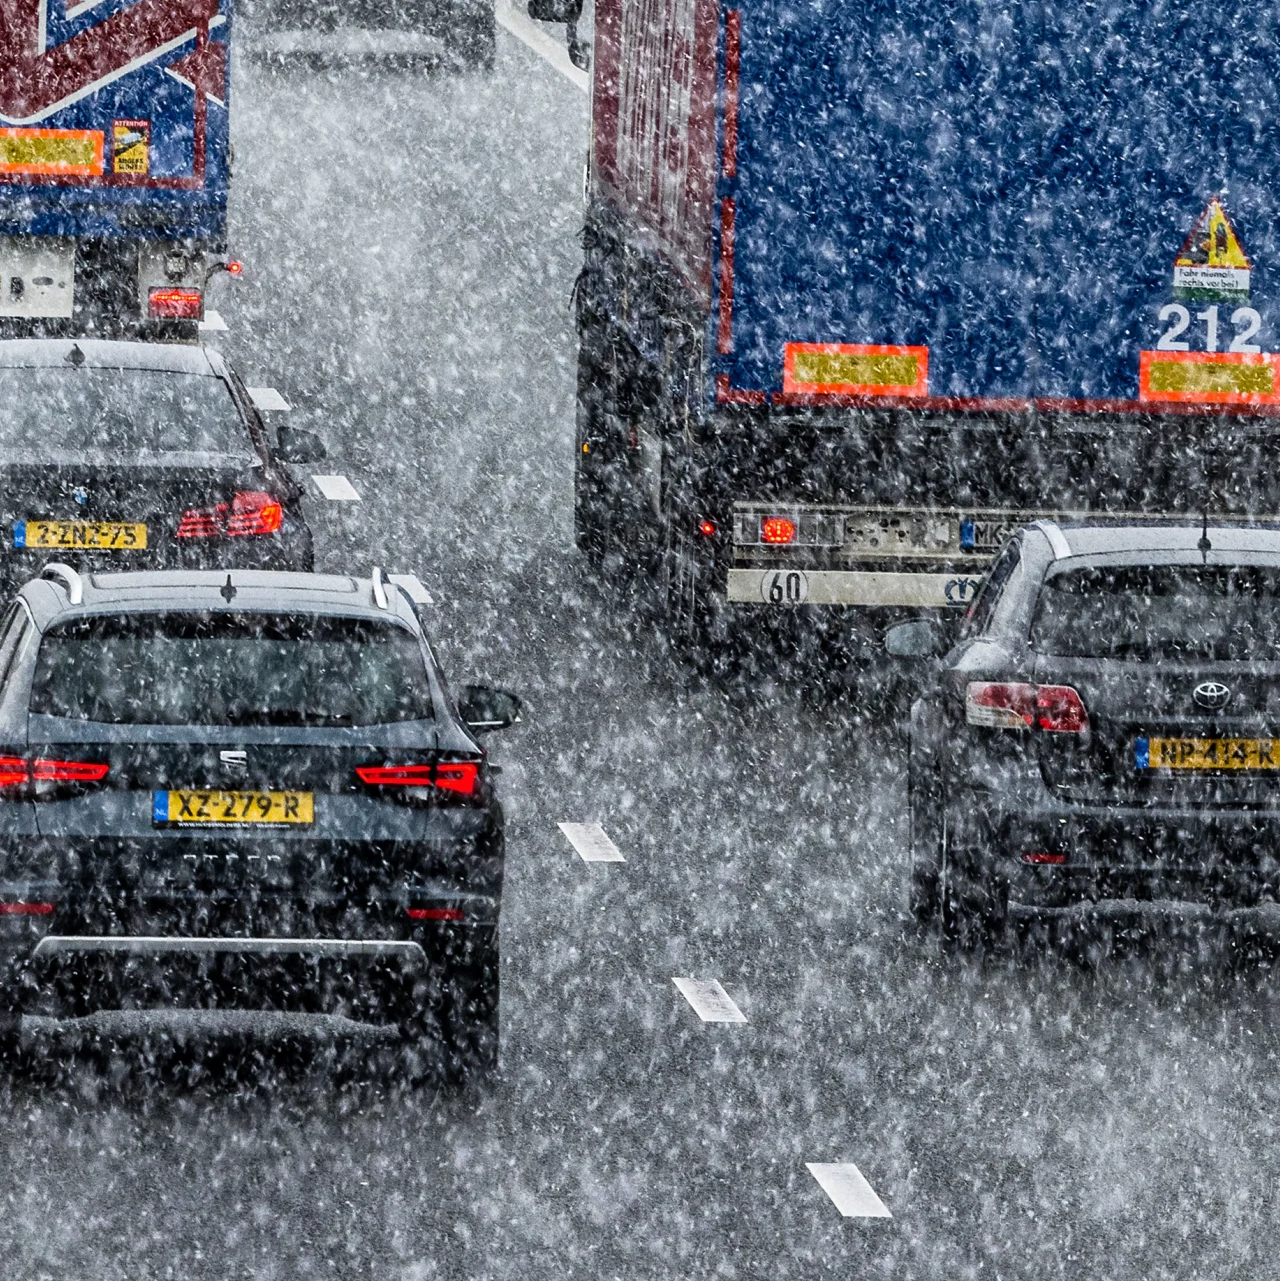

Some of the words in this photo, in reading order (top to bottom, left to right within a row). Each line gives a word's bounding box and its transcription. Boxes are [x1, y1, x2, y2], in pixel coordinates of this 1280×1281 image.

[1157, 303, 1263, 354] 212
[768, 570, 801, 601] 60
[178, 793, 299, 819] XZ-279-R
